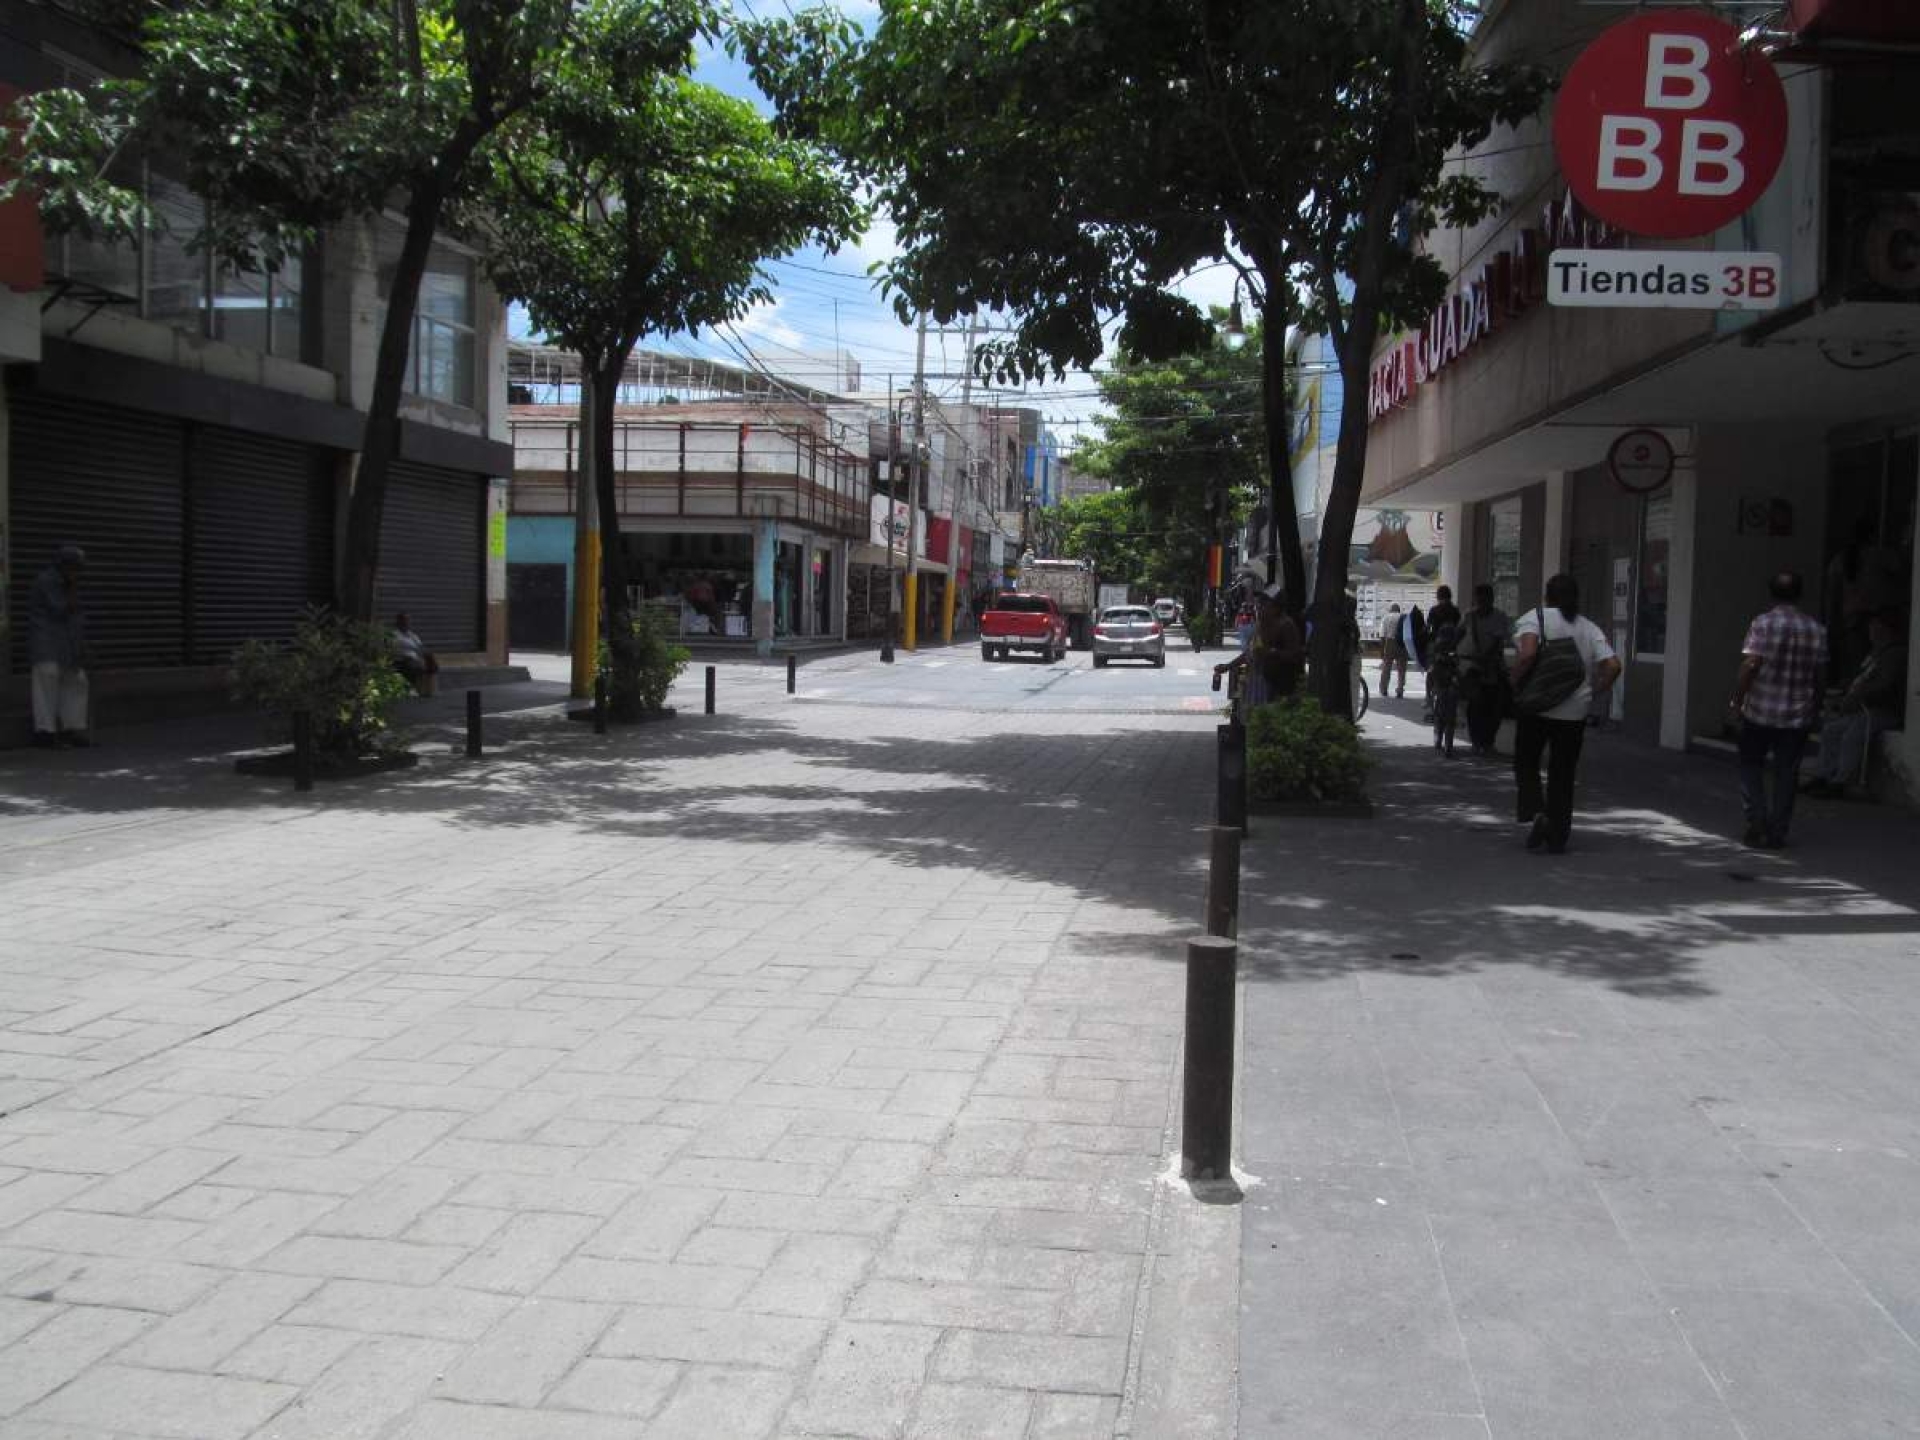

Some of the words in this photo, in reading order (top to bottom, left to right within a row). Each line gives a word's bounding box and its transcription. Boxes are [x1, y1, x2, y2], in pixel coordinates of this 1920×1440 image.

[1644, 33, 1712, 110] B
[1553, 261, 1710, 295] Tiendas
[1721, 265, 1777, 298] 3B
